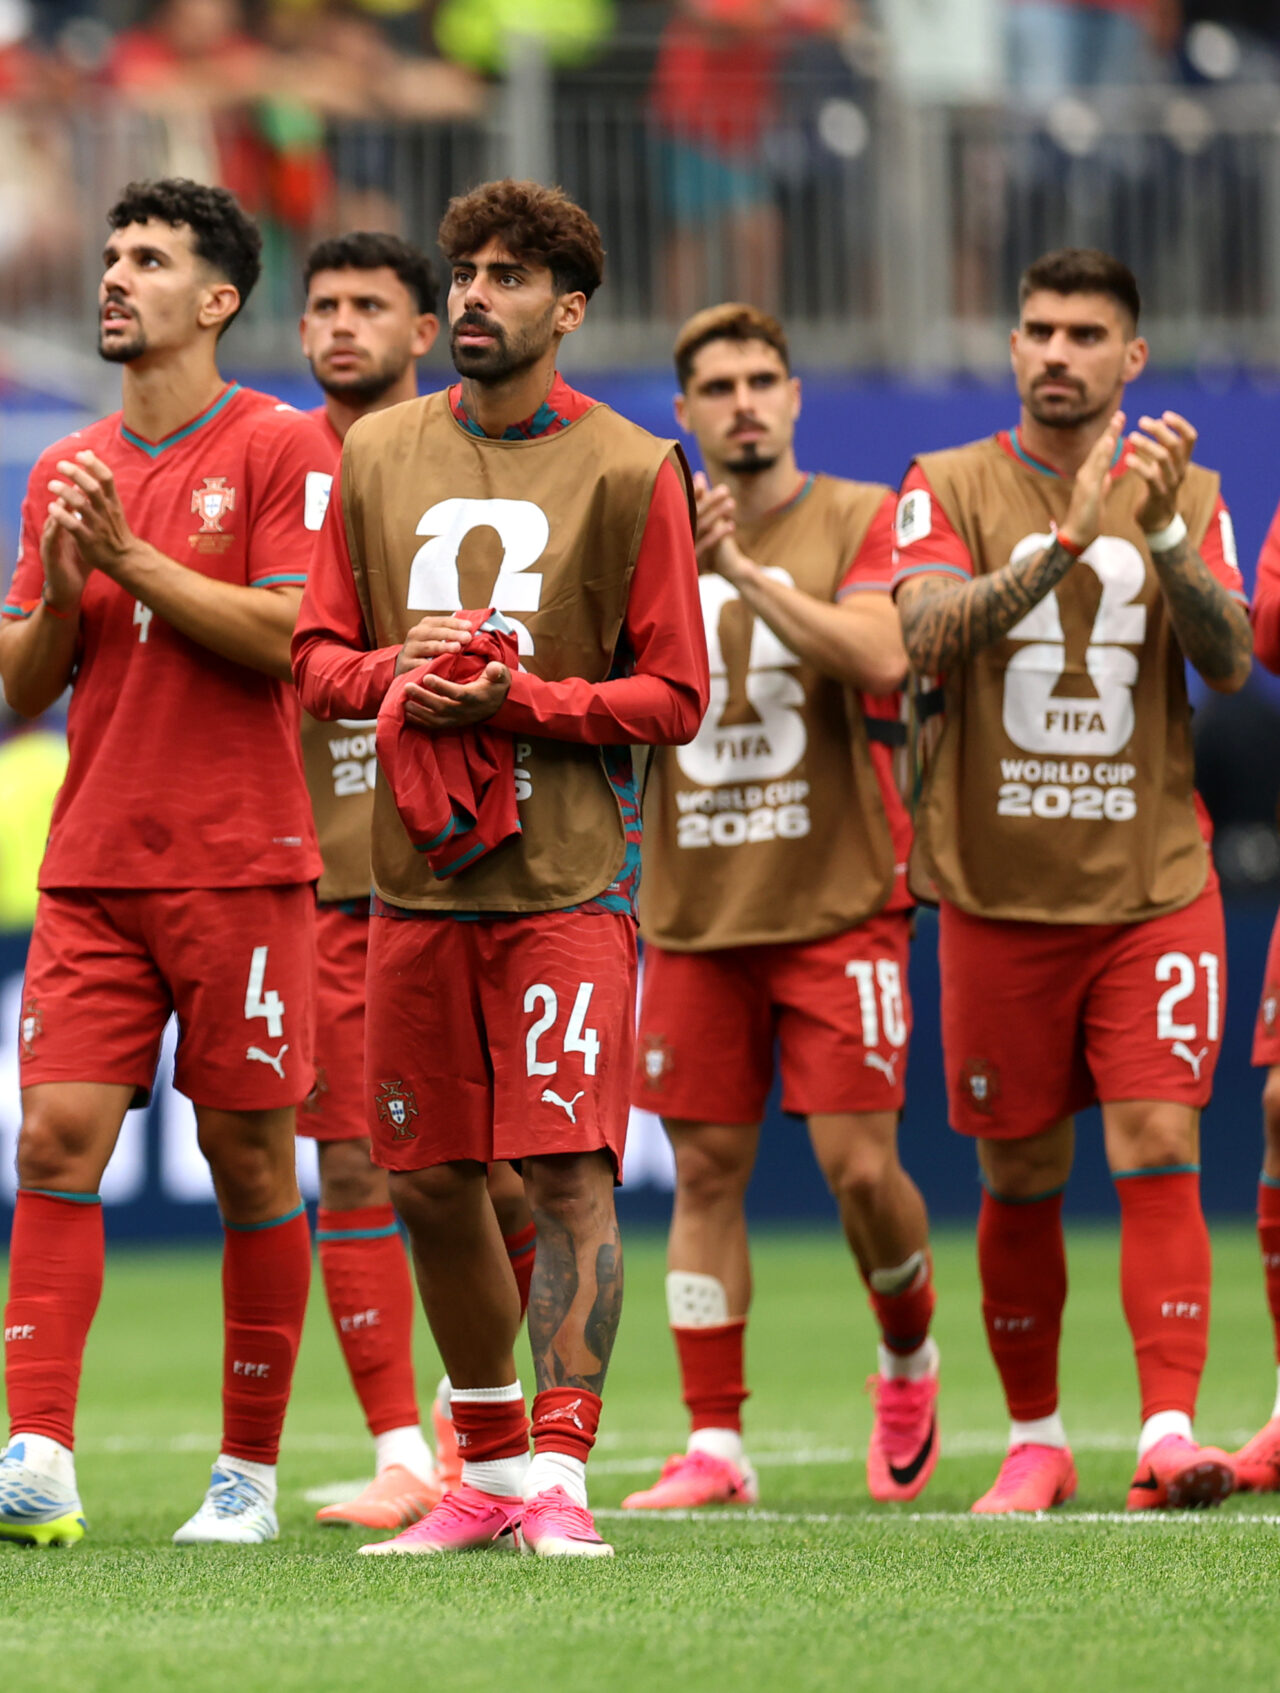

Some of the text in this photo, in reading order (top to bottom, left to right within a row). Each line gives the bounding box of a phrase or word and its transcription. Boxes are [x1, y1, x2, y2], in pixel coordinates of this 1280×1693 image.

[1045, 711, 1106, 733] FIFA
[715, 734, 773, 762] FIFA
[999, 758, 1137, 786] WORLD CUP
[676, 779, 810, 815] WORLD CUP
[996, 781, 1138, 822] 2026
[676, 802, 811, 849] 2026
[245, 946, 285, 1038] 4
[845, 959, 907, 1047] 18
[1156, 951, 1219, 1041] 21
[523, 982, 601, 1077] 24
